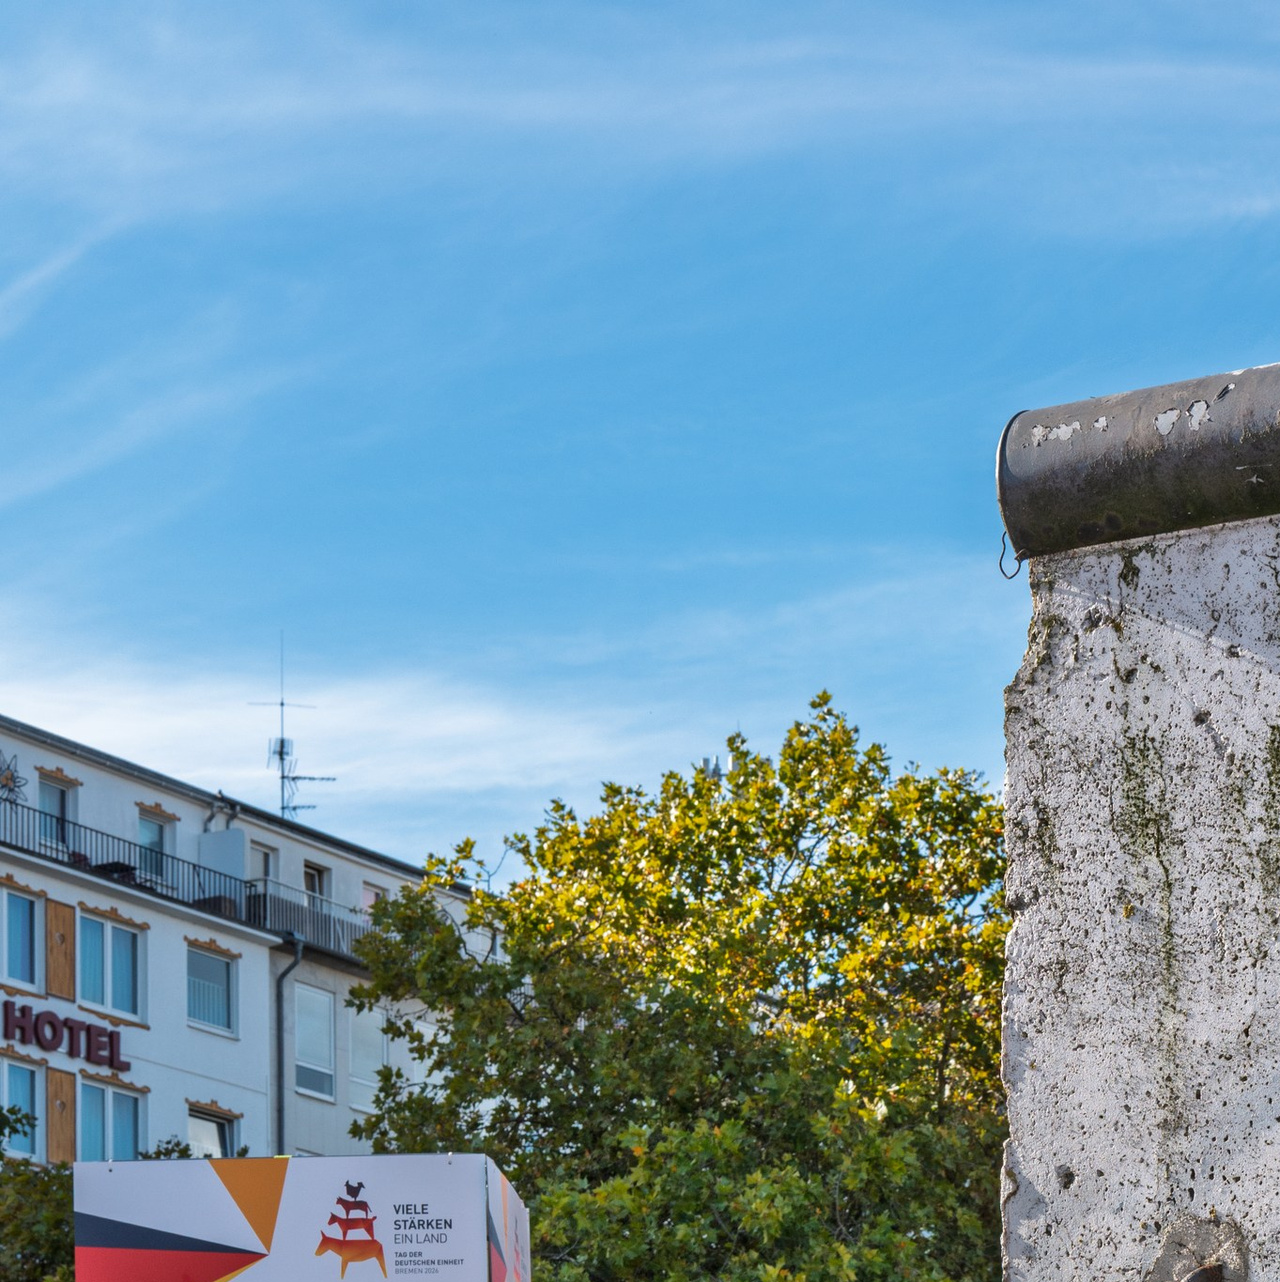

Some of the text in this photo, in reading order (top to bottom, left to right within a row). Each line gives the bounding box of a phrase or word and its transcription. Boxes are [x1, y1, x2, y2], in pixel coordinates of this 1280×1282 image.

[3, 1000, 131, 1072] HOTEL
[393, 1203, 429, 1215] VIELE
[393, 1217, 453, 1230] STÄRKEN
[394, 1233, 448, 1245] EIN LAND
